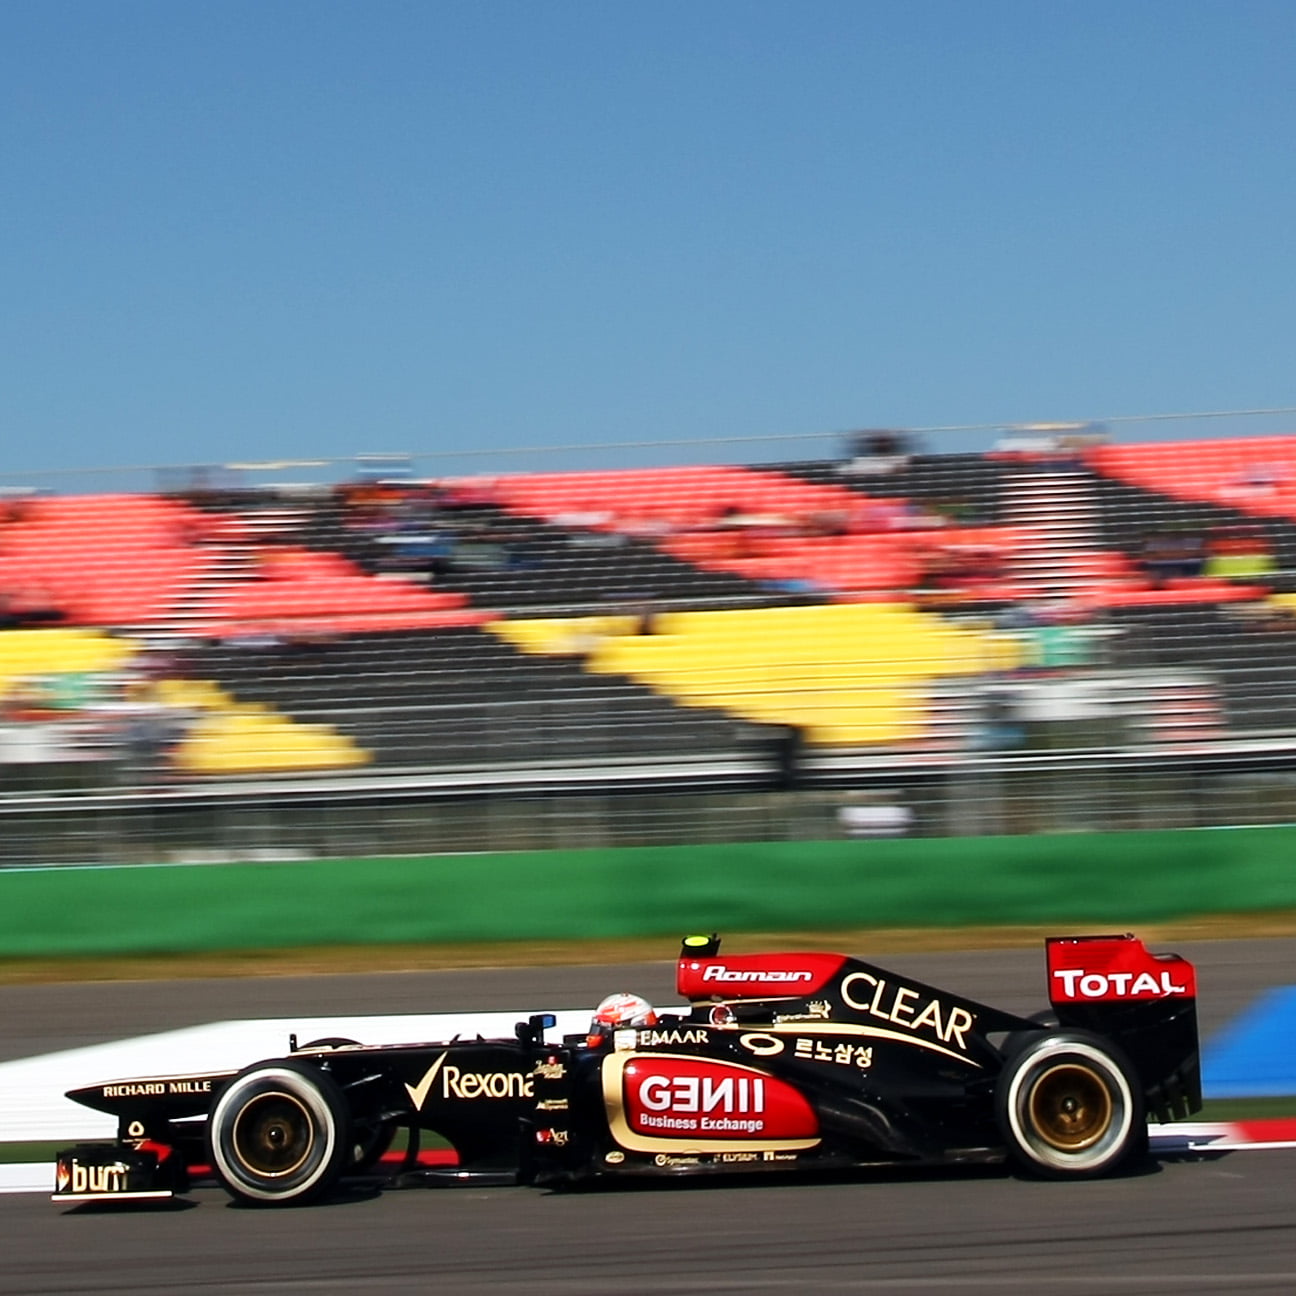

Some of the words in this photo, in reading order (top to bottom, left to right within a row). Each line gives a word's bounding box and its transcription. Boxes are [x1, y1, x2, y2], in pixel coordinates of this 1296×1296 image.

[703, 966, 812, 982] Romain
[1054, 969, 1185, 997] TOTAL
[841, 972, 973, 1050] CLEAR
[640, 1029, 709, 1045] EMAAR
[794, 1038, 873, 1068] 르노삼성
[104, 1083, 165, 1097] RICHARD
[170, 1081, 212, 1093] MILLE
[640, 1114, 697, 1129] Business
[701, 1117, 764, 1133] Exchange
[72, 1158, 128, 1192] burn
